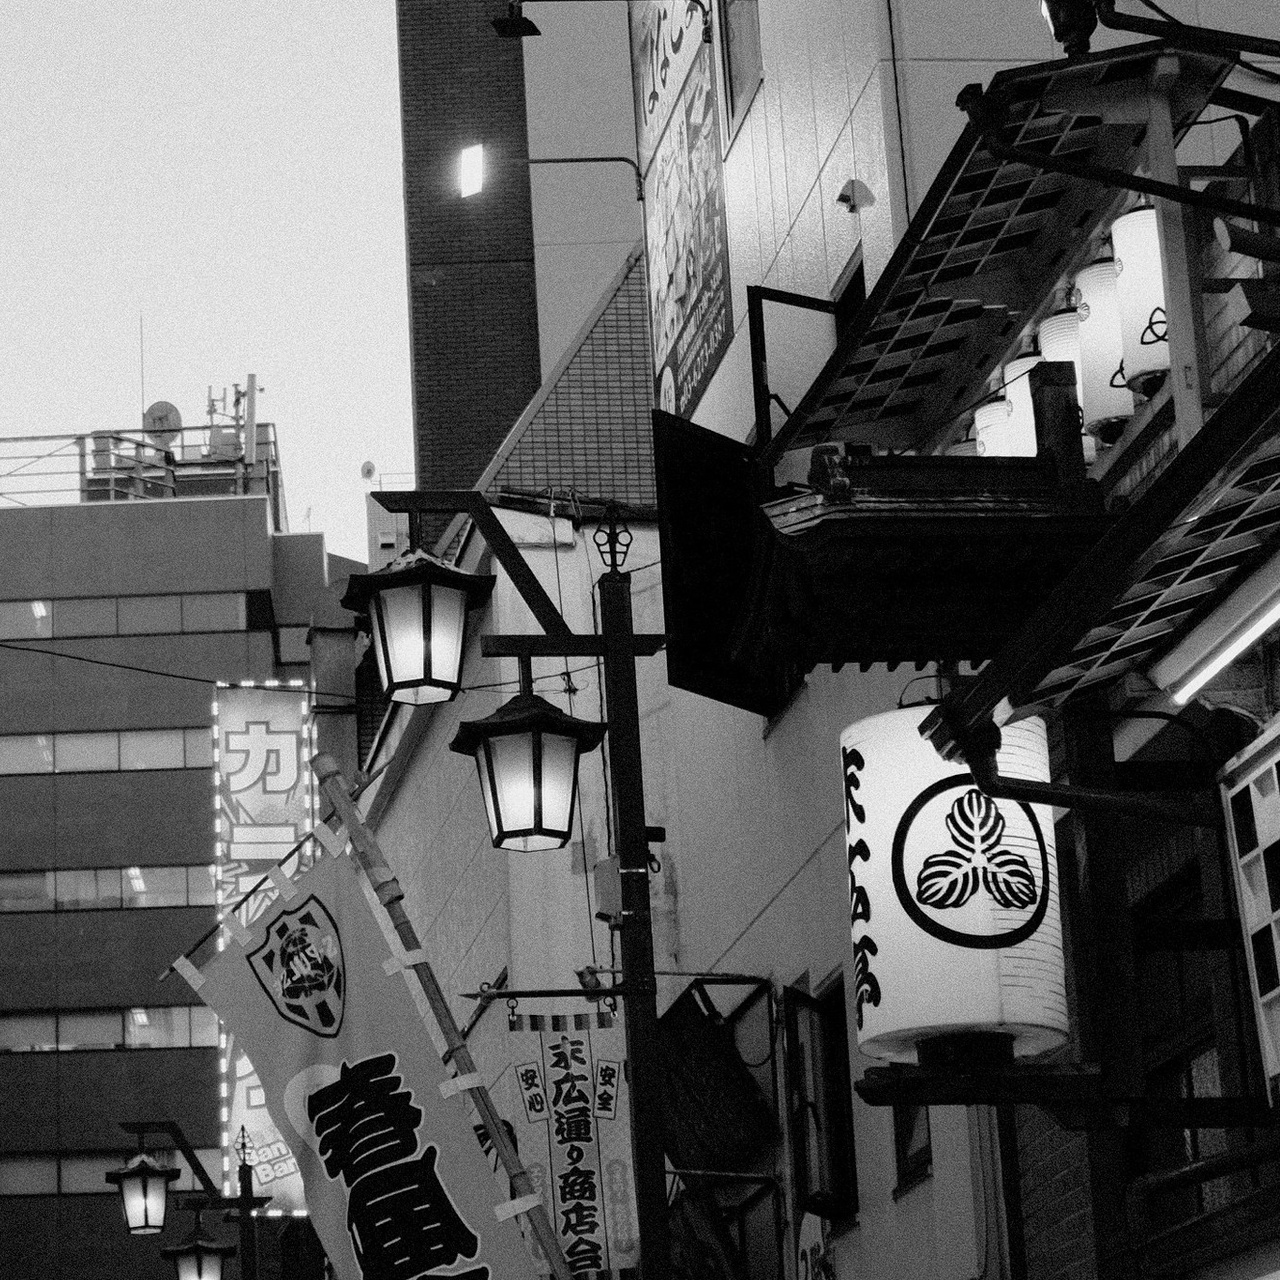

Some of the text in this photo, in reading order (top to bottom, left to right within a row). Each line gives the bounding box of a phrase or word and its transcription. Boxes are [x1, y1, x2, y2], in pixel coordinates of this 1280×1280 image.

[519, 1069, 544, 1114] 安心
[596, 1066, 617, 1113] 安全
[548, 1035, 604, 1274] 末広通り商店会
